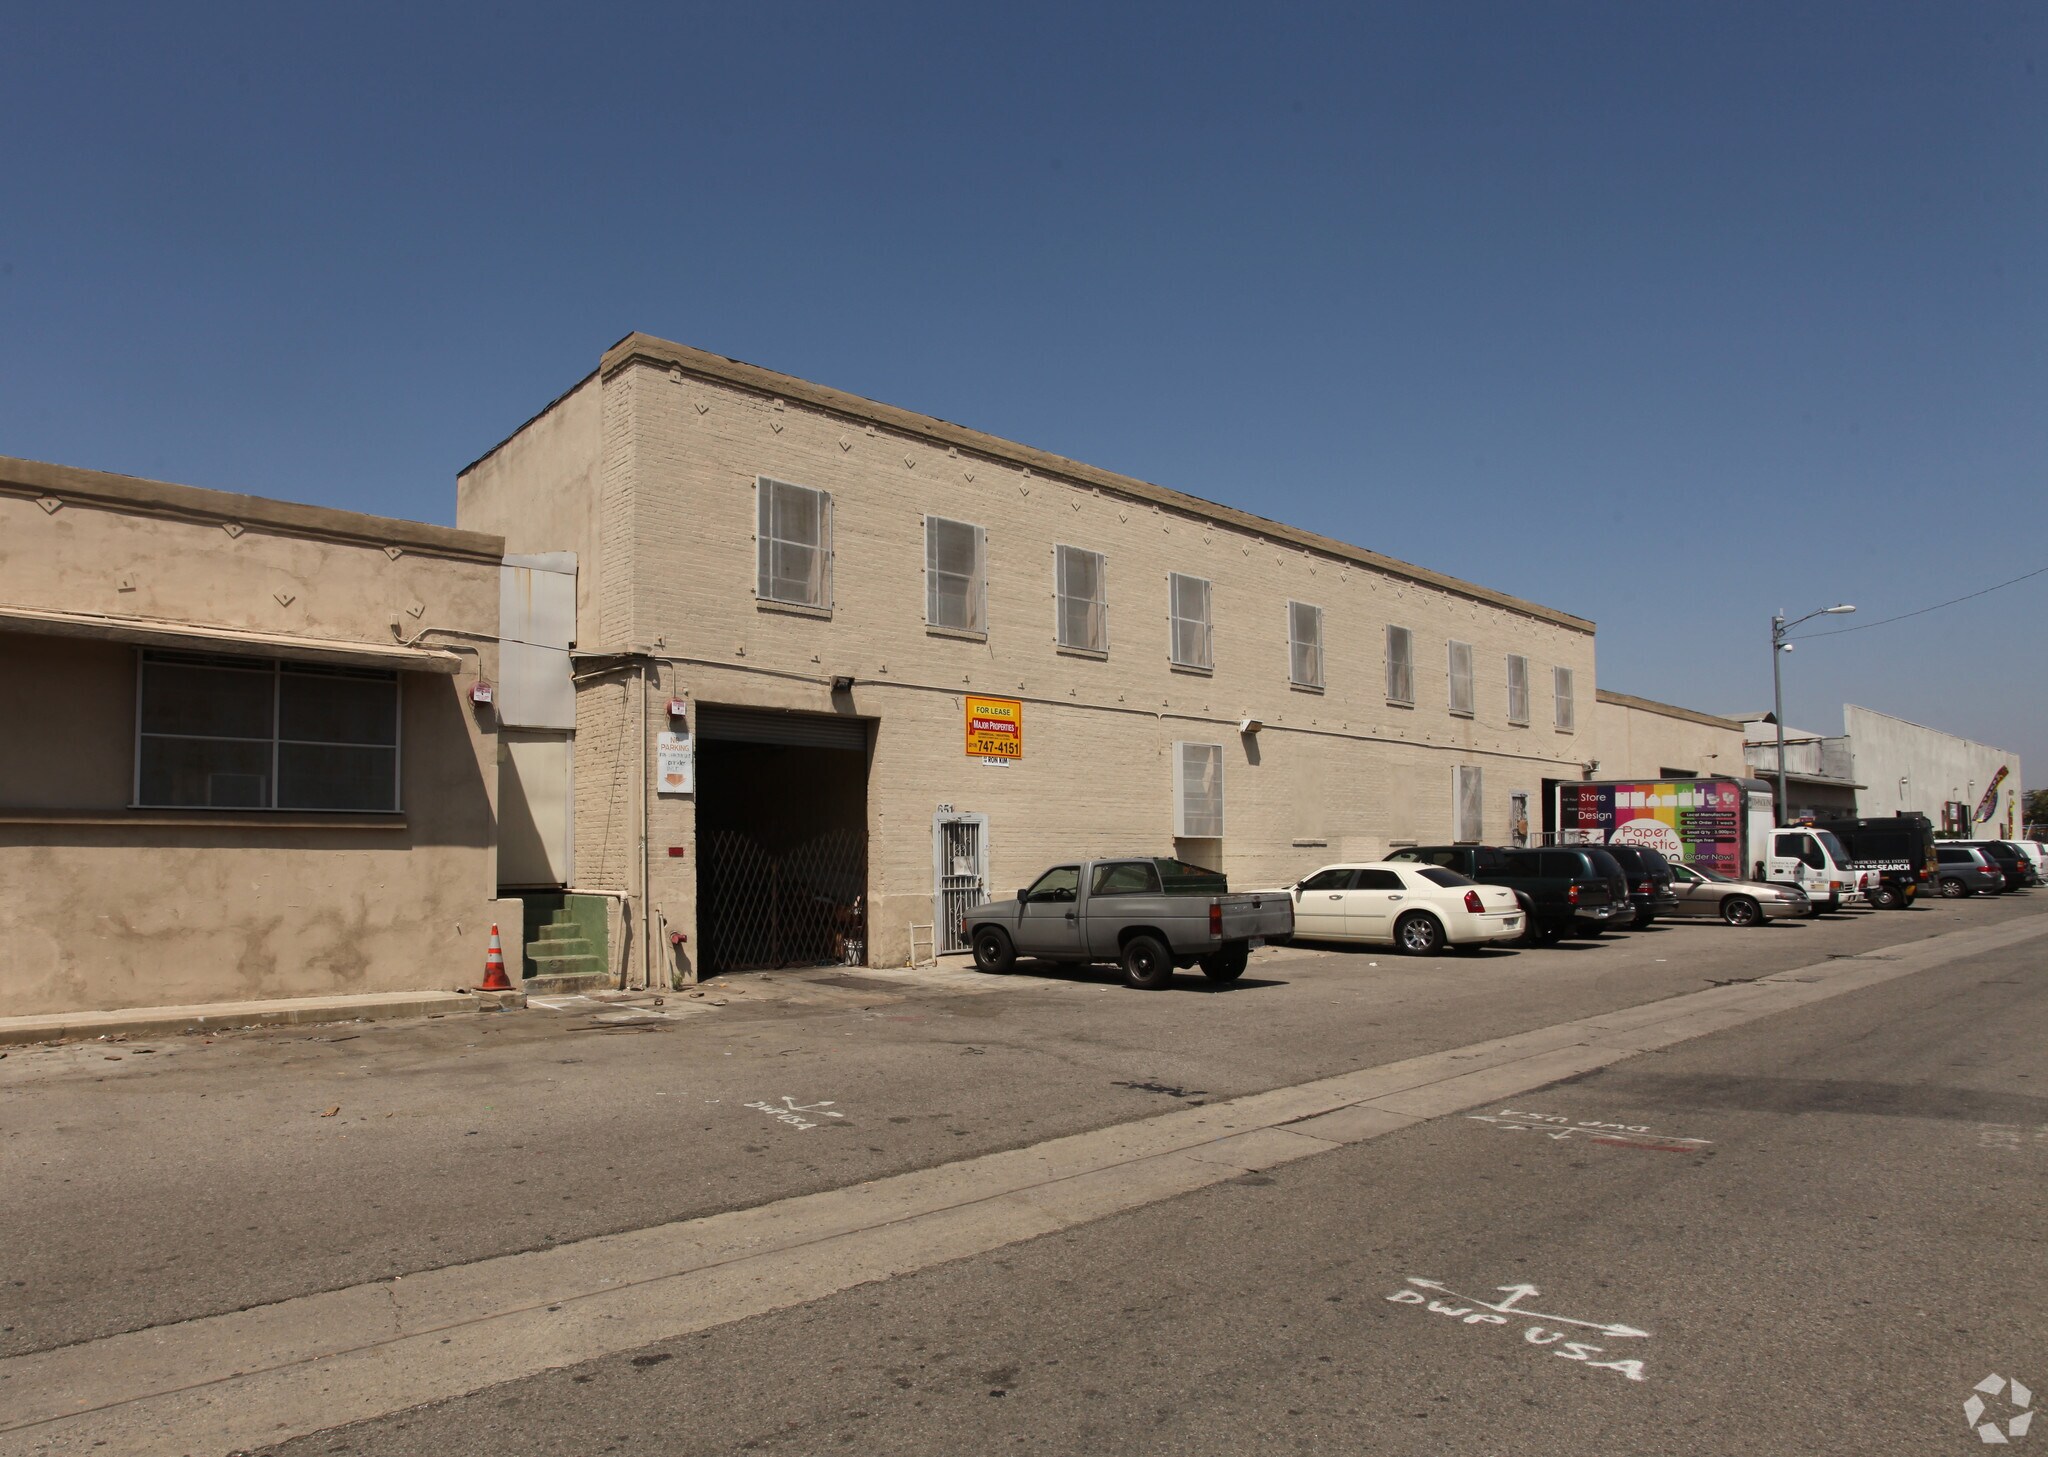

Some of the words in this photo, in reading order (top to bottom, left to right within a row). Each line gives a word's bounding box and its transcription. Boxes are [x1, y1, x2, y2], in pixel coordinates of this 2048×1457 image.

[976, 706, 989, 714] FOR
[991, 707, 1011, 716] LEASE
[660, 743, 690, 752] PARKING
[978, 740, 1019, 754] 747-4151
[1580, 793, 1607, 802] Store
[937, 804, 954, 813] 651
[1578, 811, 1612, 821] Design
[1622, 825, 1669, 839] Paper
[1684, 853, 1710, 861] Order
[1711, 853, 1734, 861] Now!
[1866, 863, 1911, 871] RESEARCH
[1523, 1326, 1648, 1382] USA
